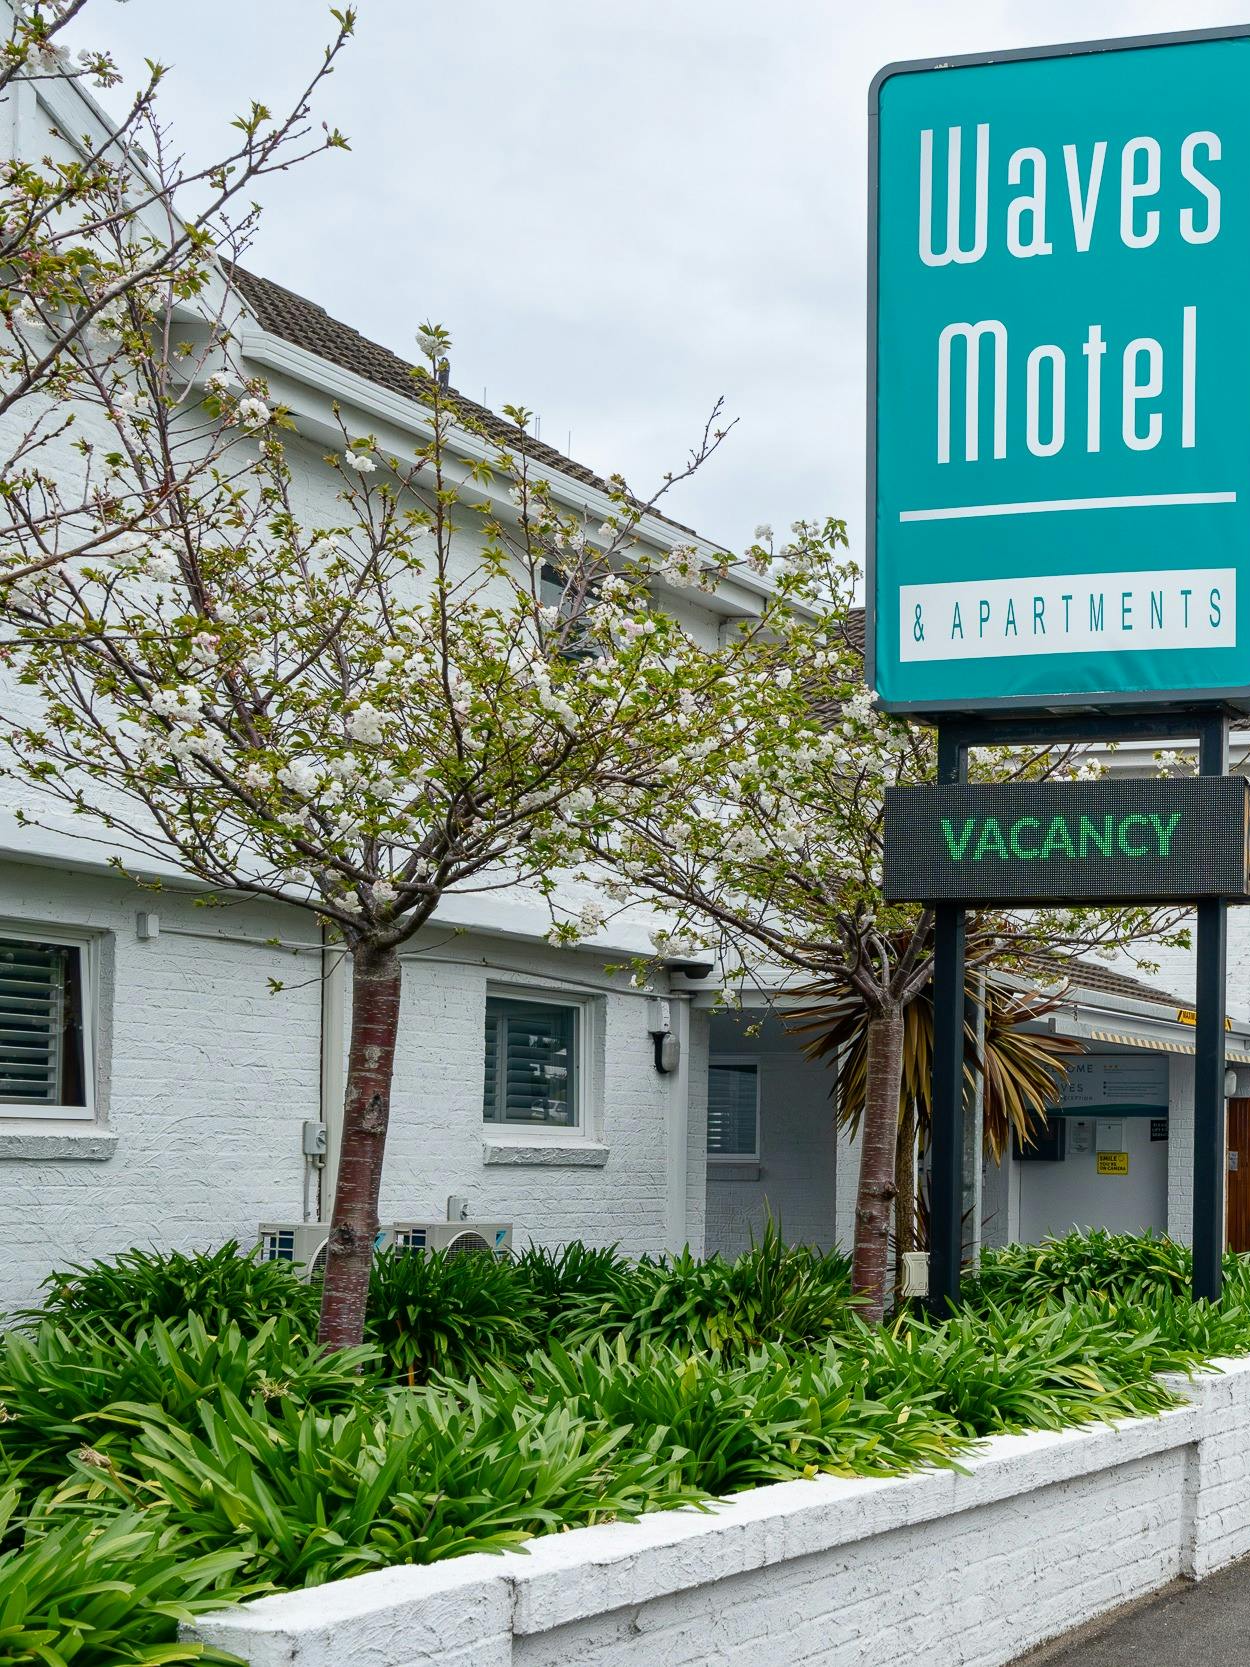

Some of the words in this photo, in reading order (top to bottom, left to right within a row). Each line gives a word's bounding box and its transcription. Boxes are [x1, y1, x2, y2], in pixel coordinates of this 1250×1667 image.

[918, 122, 1222, 267] Waves
[937, 305, 1198, 464] Motel
[913, 603, 926, 642] &
[951, 588, 1222, 641] APARTMENTS
[940, 812, 1182, 860] VACANCY
